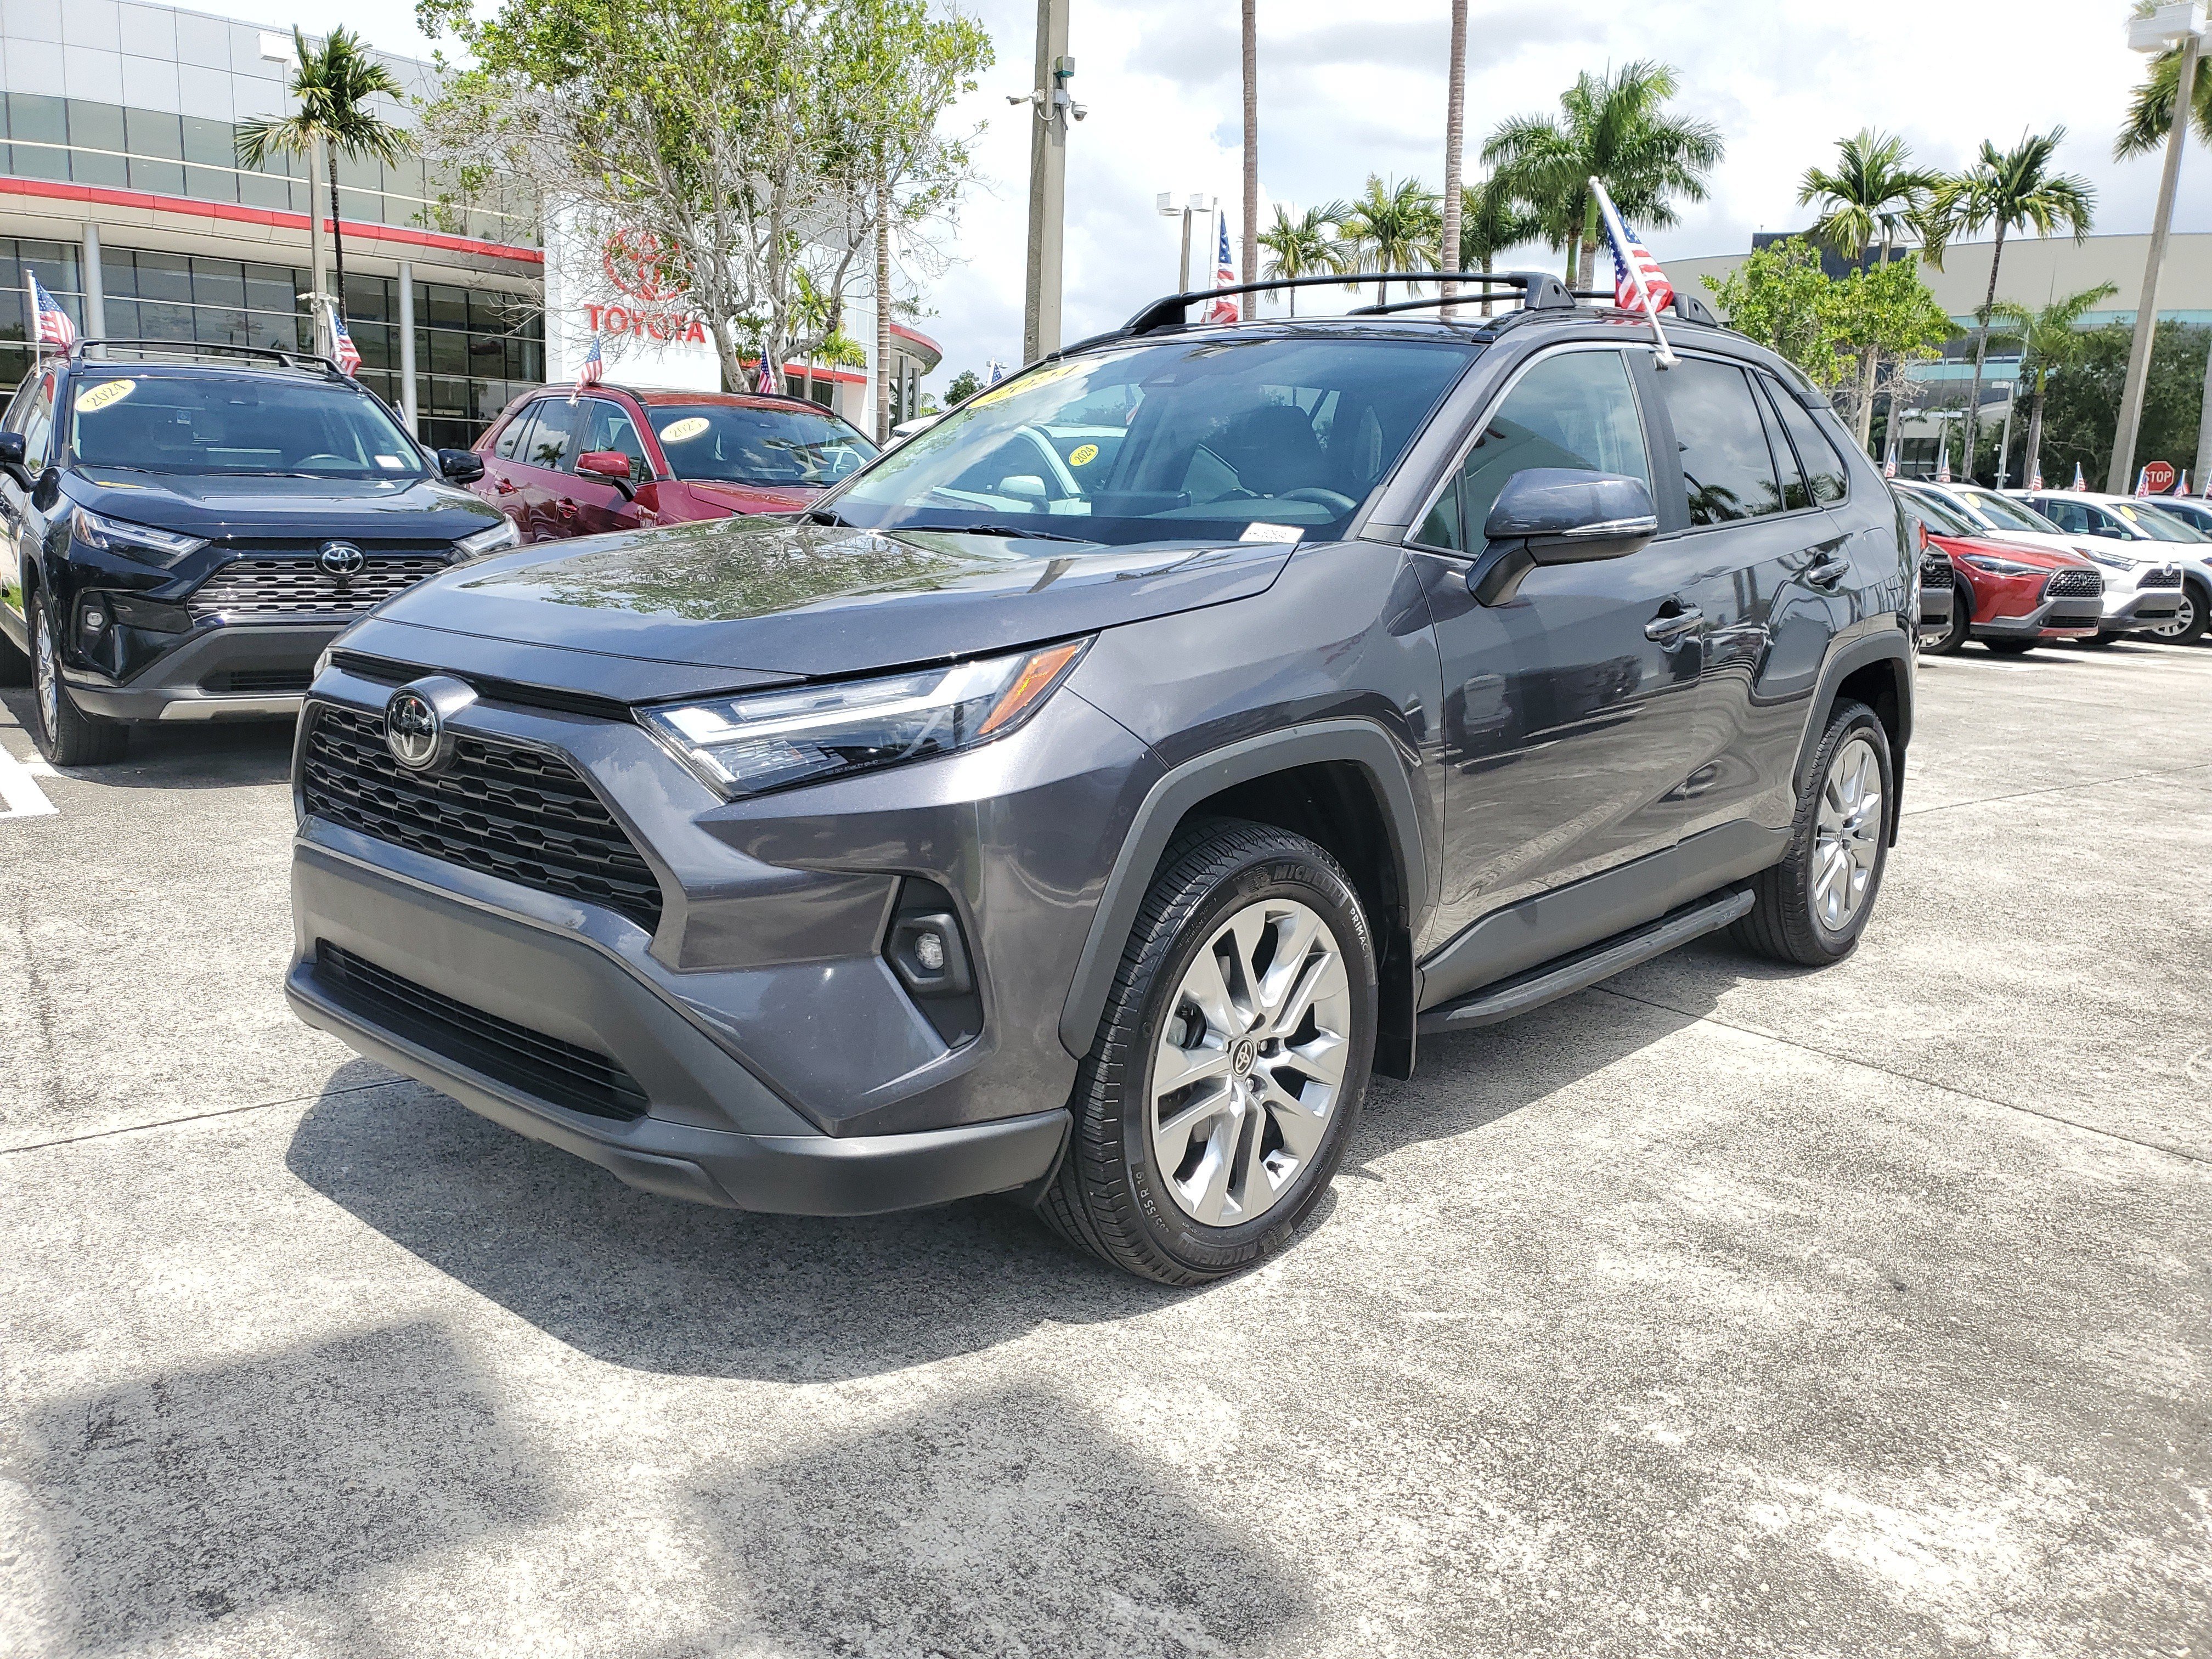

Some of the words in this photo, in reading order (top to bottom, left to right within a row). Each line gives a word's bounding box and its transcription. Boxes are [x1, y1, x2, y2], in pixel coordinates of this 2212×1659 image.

[584, 304, 706, 343] TOYOTA
[86, 383, 127, 407] 2024
[1074, 446, 1095, 464] 2024
[2145, 470, 2172, 483] STOP
